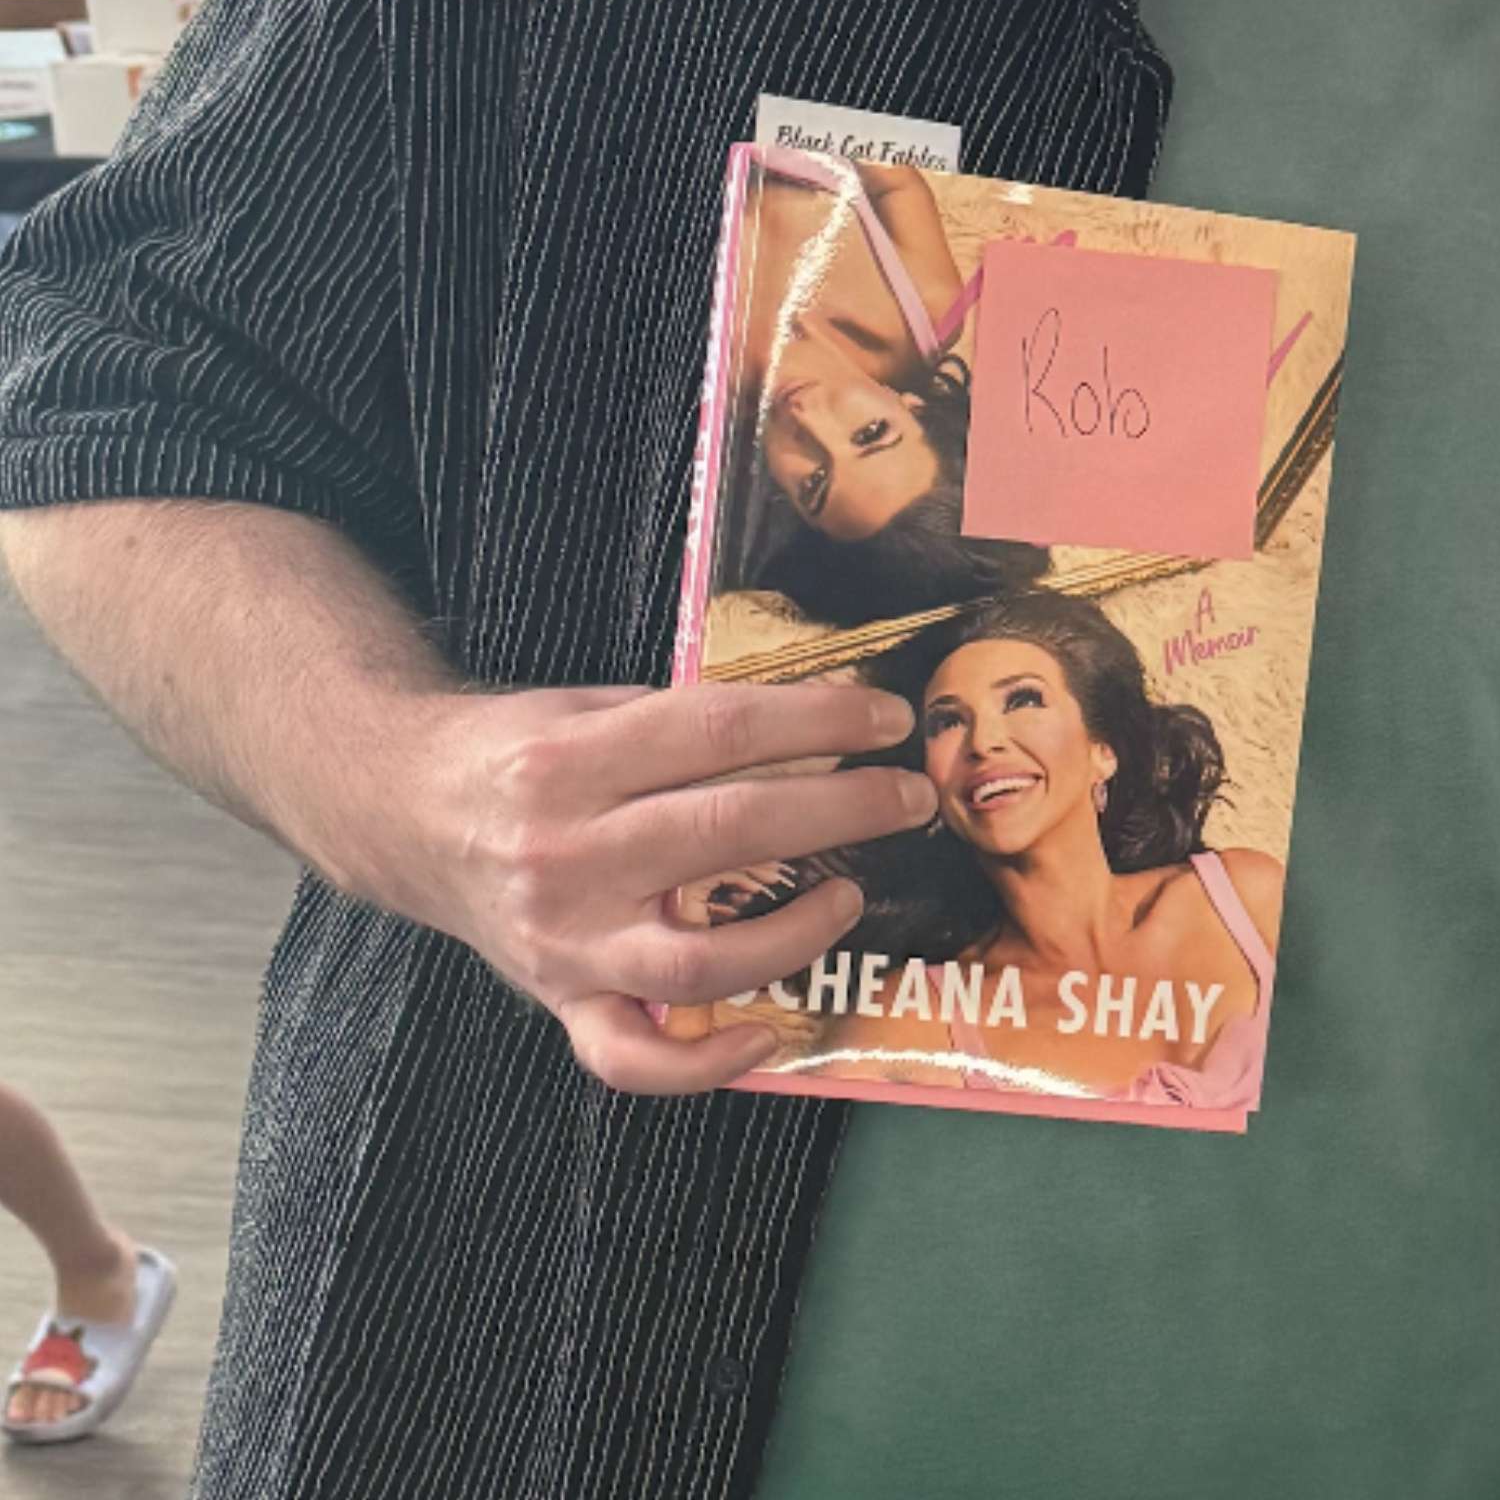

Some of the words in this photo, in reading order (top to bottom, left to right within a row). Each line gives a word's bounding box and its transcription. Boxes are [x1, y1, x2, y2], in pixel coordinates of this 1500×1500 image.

[775, 124, 834, 155] Black
[839, 134, 876, 161] Cat
[879, 140, 949, 172] Fables
[1021, 307, 1152, 439] Rob
[1195, 586, 1216, 635] A
[1163, 625, 1262, 677] Memoir
[726, 950, 1028, 1029] HEANA
[1056, 969, 1226, 1045] SHAY
